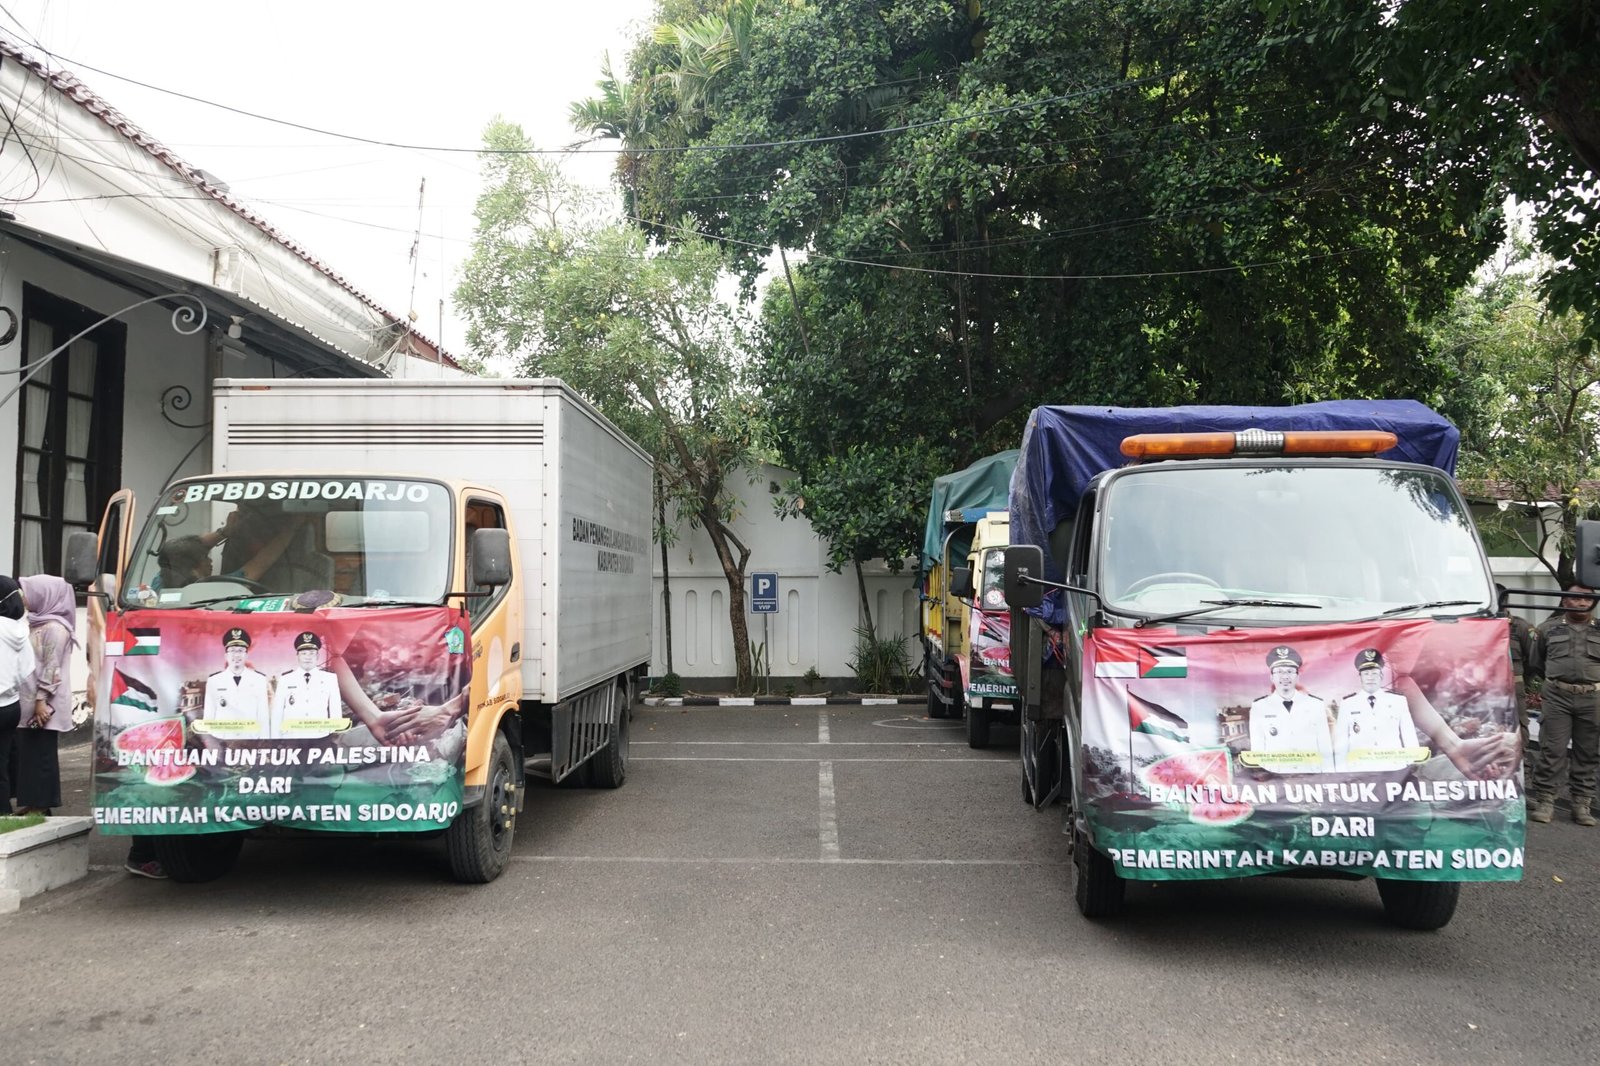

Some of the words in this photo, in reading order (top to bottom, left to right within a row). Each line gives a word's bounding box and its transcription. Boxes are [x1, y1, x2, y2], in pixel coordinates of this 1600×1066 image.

[184, 484, 265, 502] BPBD
[268, 481, 429, 503] SIDOARJO
[758, 578, 770, 595] P
[968, 682, 1019, 695] EMERINT
[118, 748, 219, 767] BANTUAN
[224, 748, 302, 766] UNTUK
[306, 745, 431, 765] PALESTINA
[238, 776, 292, 795] DARI
[1149, 783, 1277, 804] BANTUAN
[1285, 782, 1379, 804] UNTUK
[1385, 779, 1519, 802] PALESTINA
[93, 806, 208, 825] EMERINTAH
[214, 804, 352, 823] KABUPATEN
[358, 801, 458, 823] SIDOARJO
[1311, 816, 1375, 838] DARI
[1282, 848, 1444, 870] KABUPATEN
[1450, 846, 1524, 870] SIDOA
